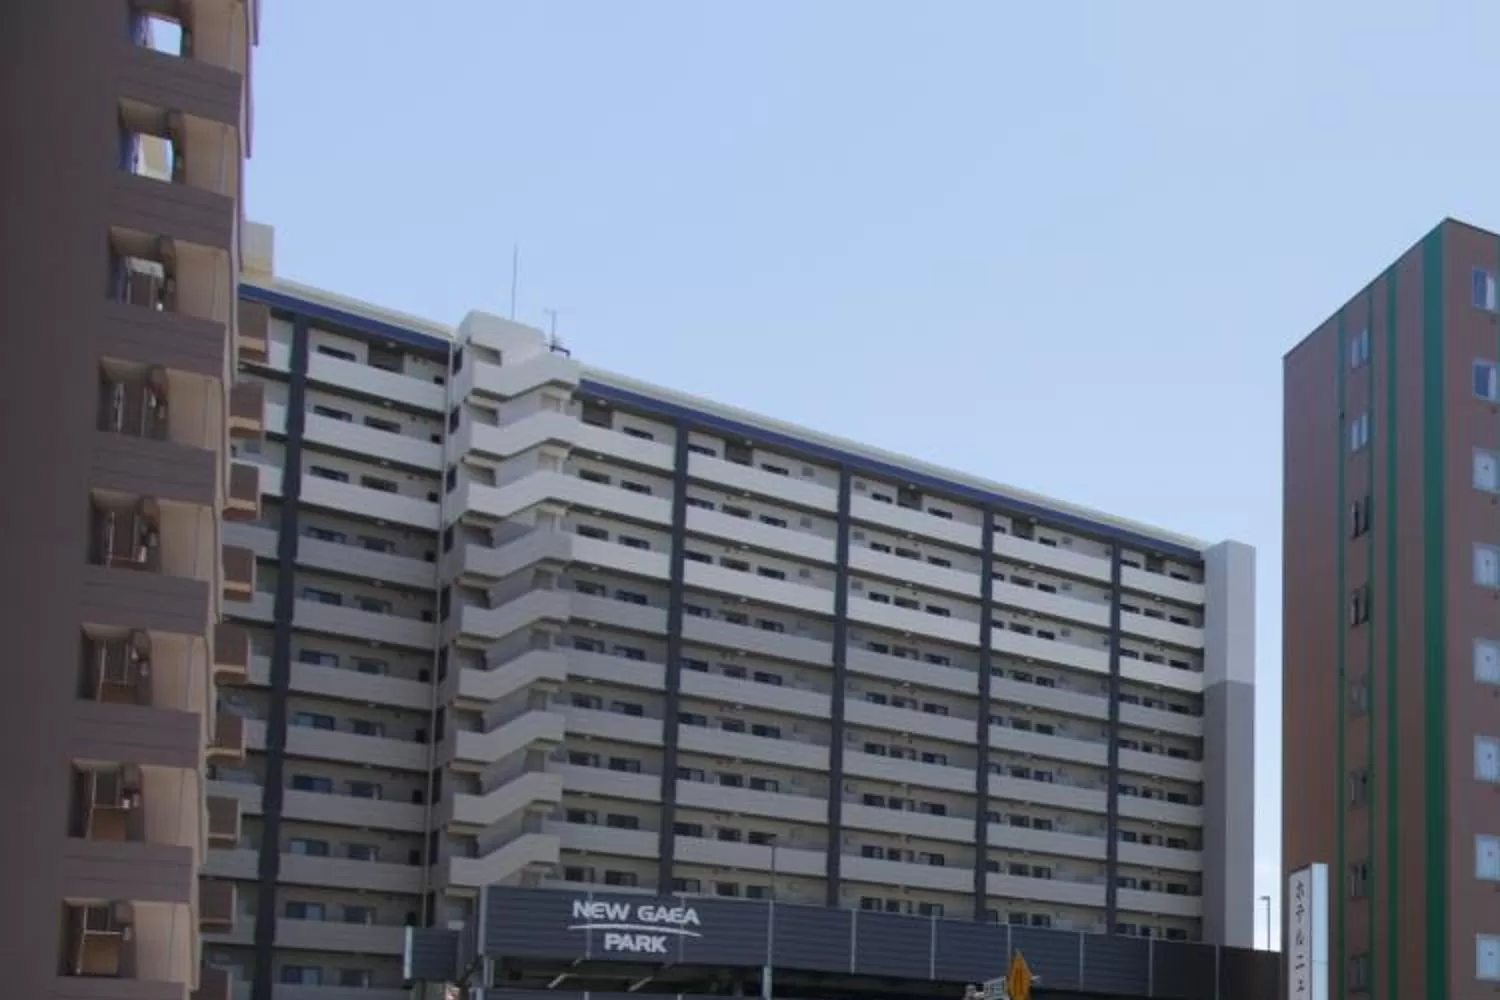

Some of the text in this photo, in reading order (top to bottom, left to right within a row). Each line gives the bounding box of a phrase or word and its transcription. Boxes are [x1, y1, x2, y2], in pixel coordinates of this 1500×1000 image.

[573, 900, 701, 925] NEW GAEA
[604, 933, 668, 953] PARK
